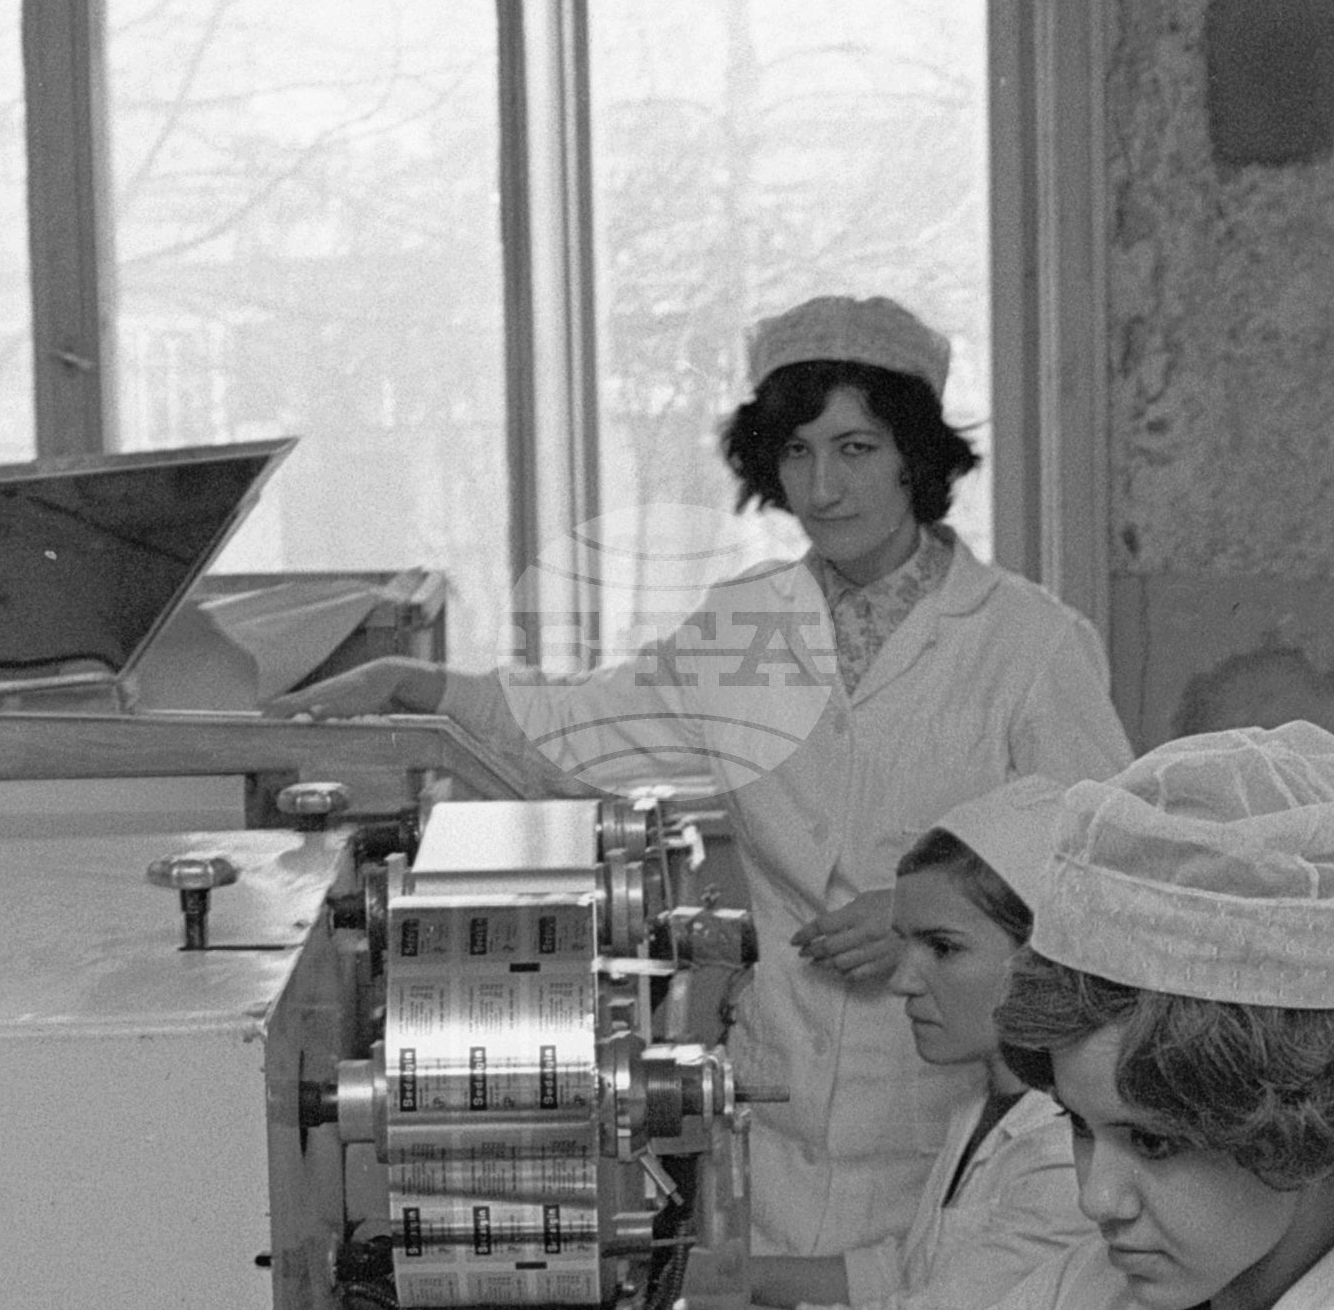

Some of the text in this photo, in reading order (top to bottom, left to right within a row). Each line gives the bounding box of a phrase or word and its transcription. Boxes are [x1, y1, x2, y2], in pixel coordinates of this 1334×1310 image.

[401, 1051, 416, 1109] Sedalgin
[471, 1049, 486, 1108] Sedalgin
[541, 1047, 556, 1107] Sedalgin
